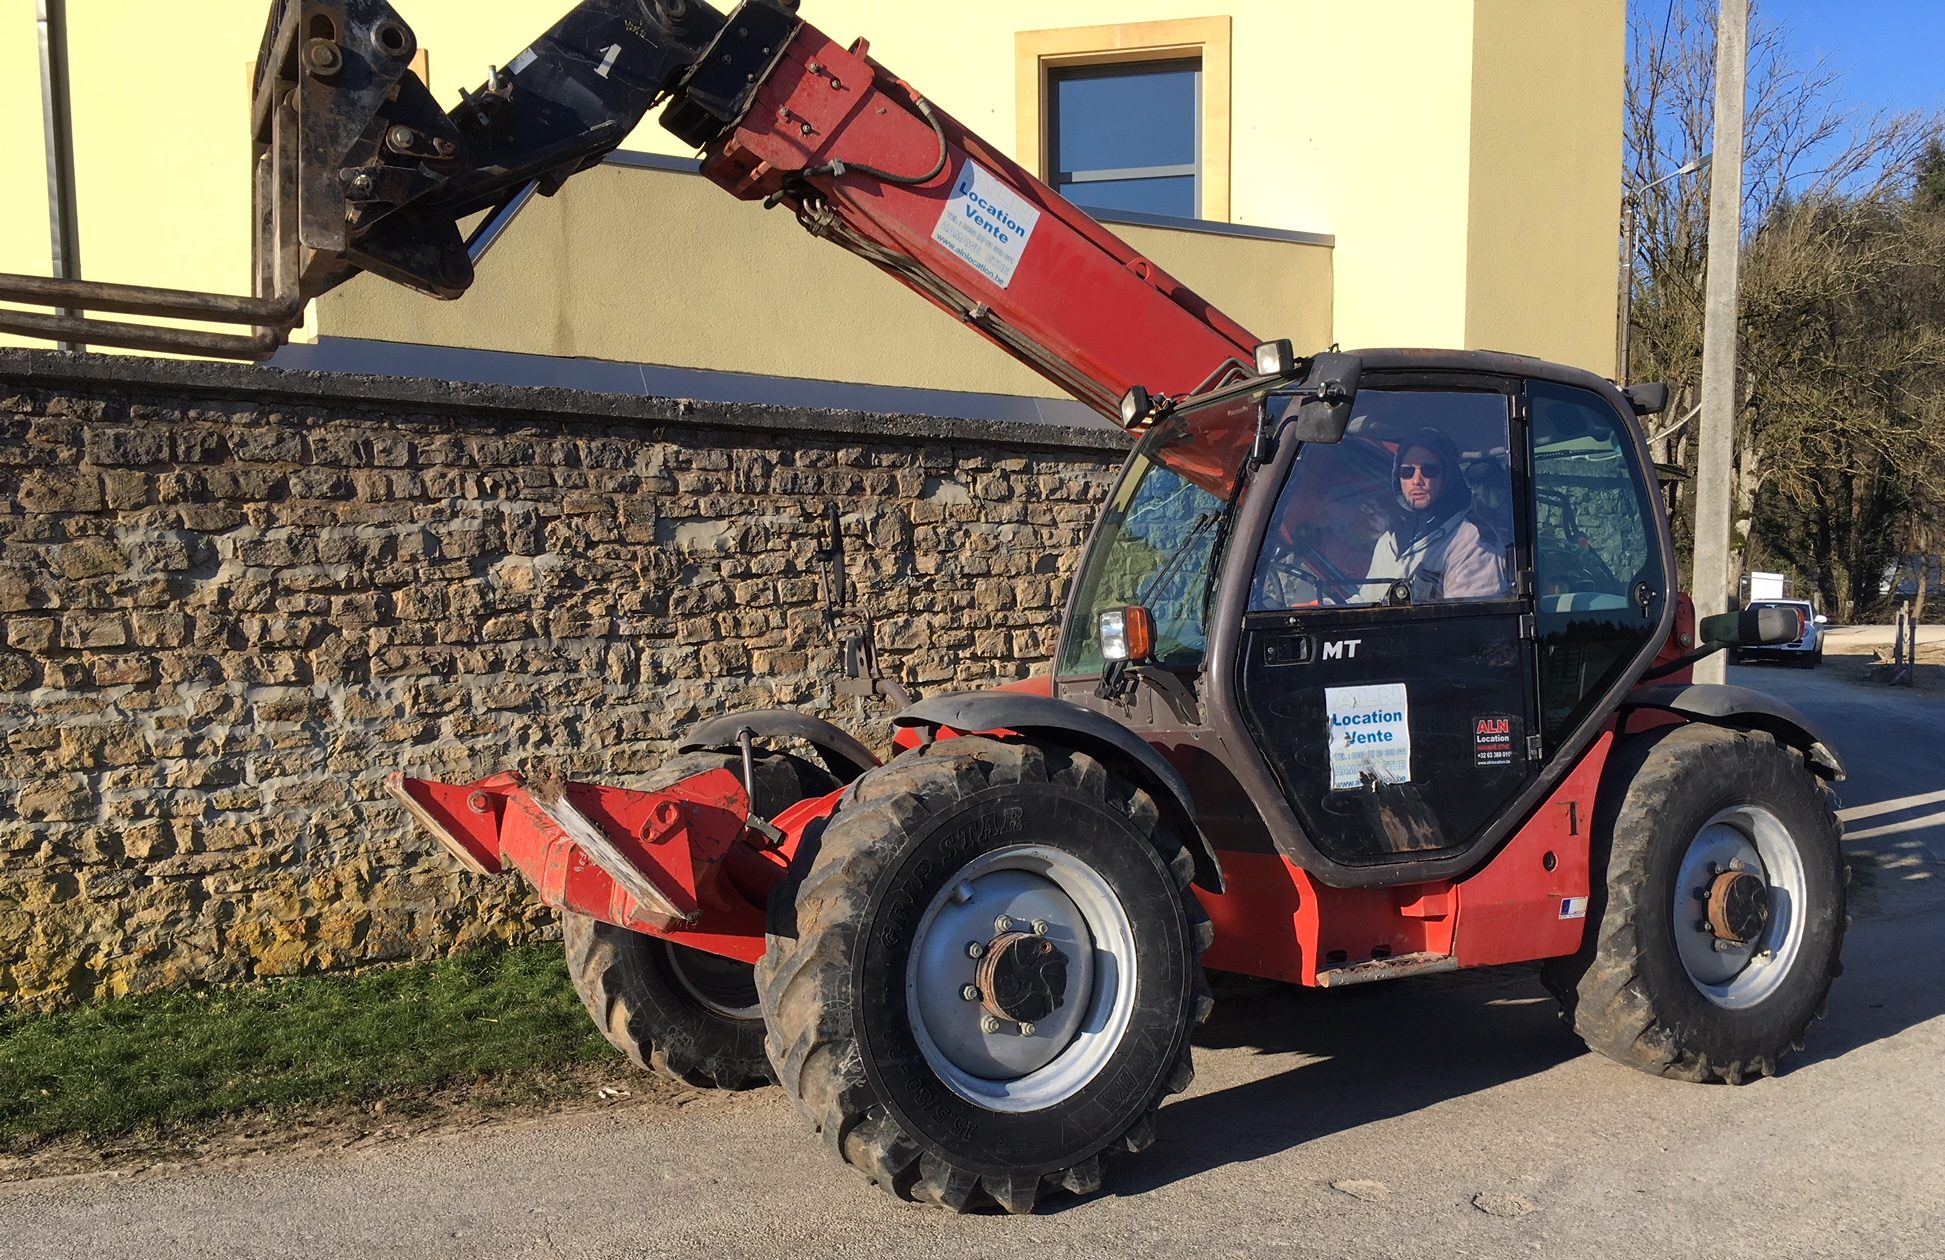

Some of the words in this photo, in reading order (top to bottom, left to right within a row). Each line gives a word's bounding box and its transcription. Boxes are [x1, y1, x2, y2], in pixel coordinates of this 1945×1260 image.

[594, 43, 622, 80] 1
[958, 181, 1026, 238] Location
[965, 204, 1009, 244] Vente
[936, 233, 1004, 285] www.alnlocation.be
[1322, 639, 1362, 660] MT
[1333, 686, 1403, 709] ALN
[1332, 709, 1403, 727] Location
[1476, 718, 1509, 734] ALN
[1344, 730, 1393, 745] Vente
[1476, 734, 1510, 743] Location
[880, 858, 933, 951] GRIP
[939, 807, 1024, 869] STAR
